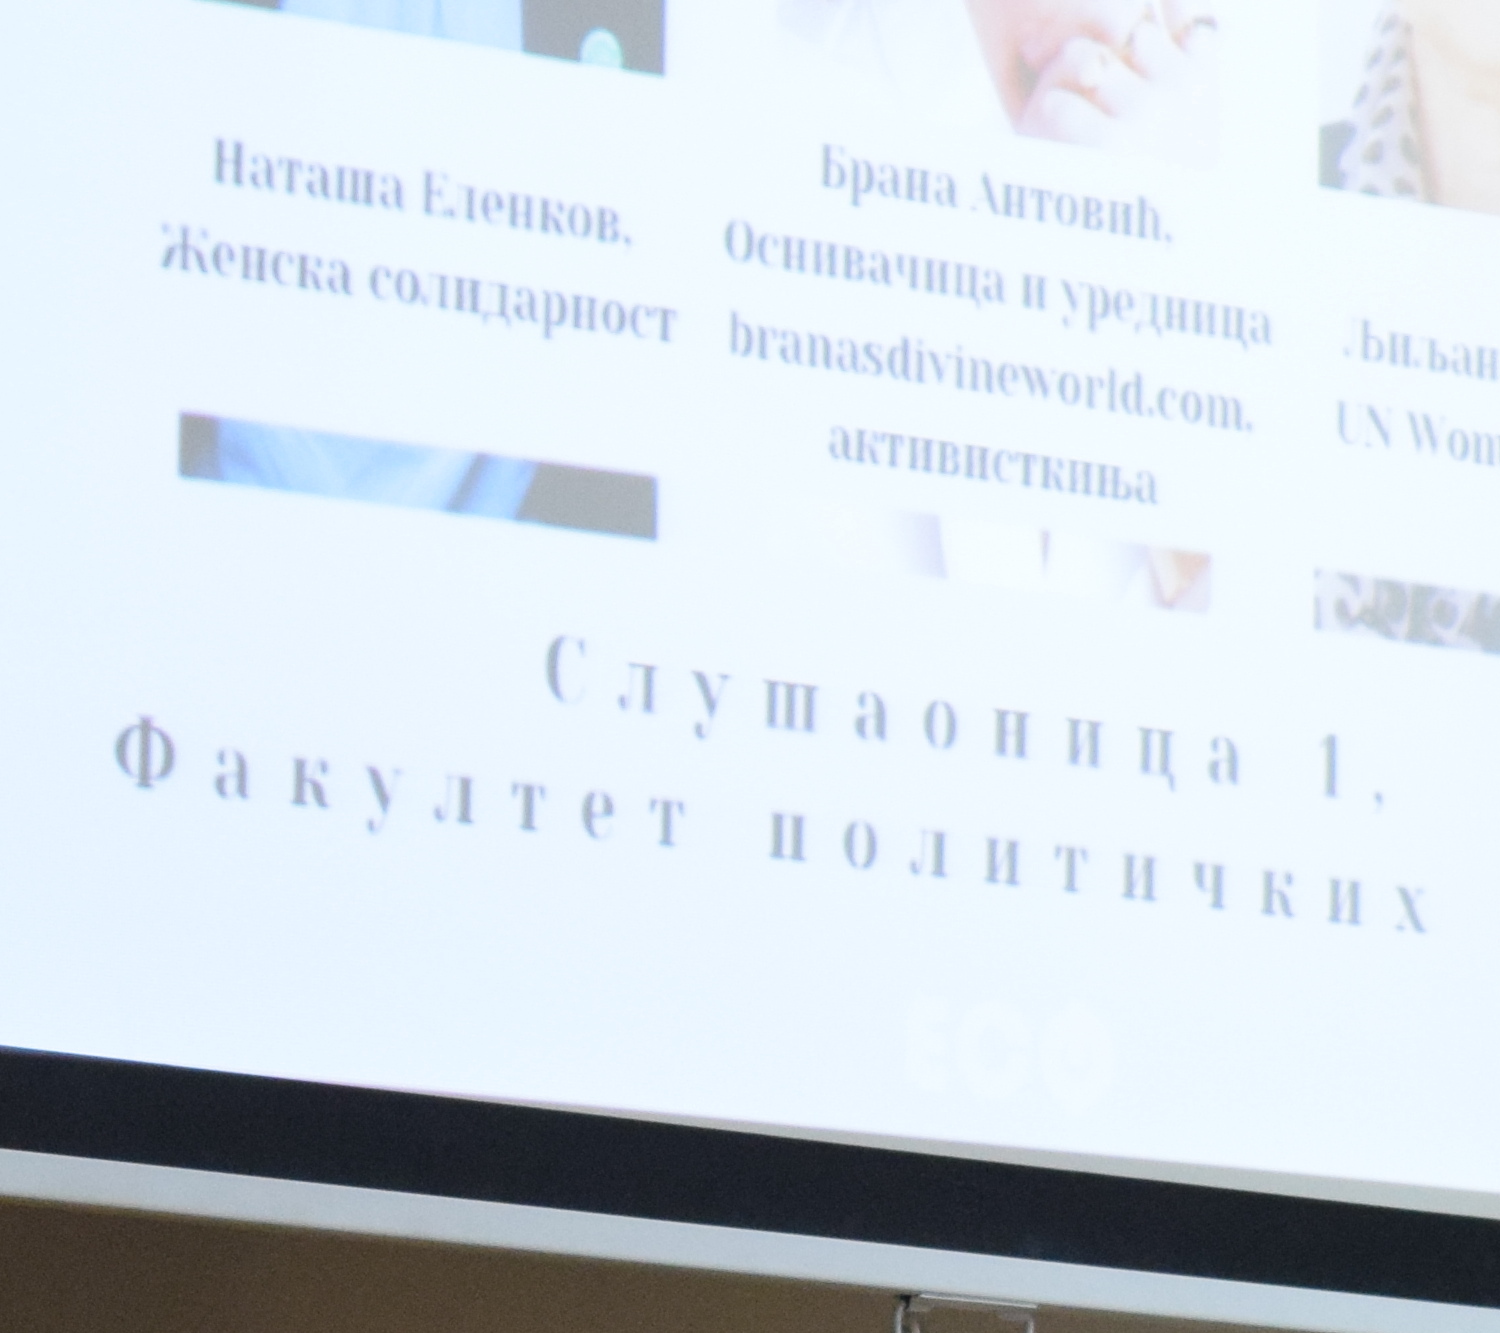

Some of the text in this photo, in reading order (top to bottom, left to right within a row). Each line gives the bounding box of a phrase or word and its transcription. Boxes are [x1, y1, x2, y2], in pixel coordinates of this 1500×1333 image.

[213, 138, 403, 210] Наташа
[820, 143, 957, 208] Брана
[160, 222, 678, 342] Женска солидарност
[724, 219, 1273, 350] Оснивачица и уредница
[828, 424, 1160, 506] активисткиња
[1336, 401, 1392, 448] UN
[544, 633, 1385, 811] Слушаоница 1,
[114, 713, 686, 834] Факултет
[769, 811, 1428, 934] политичких
